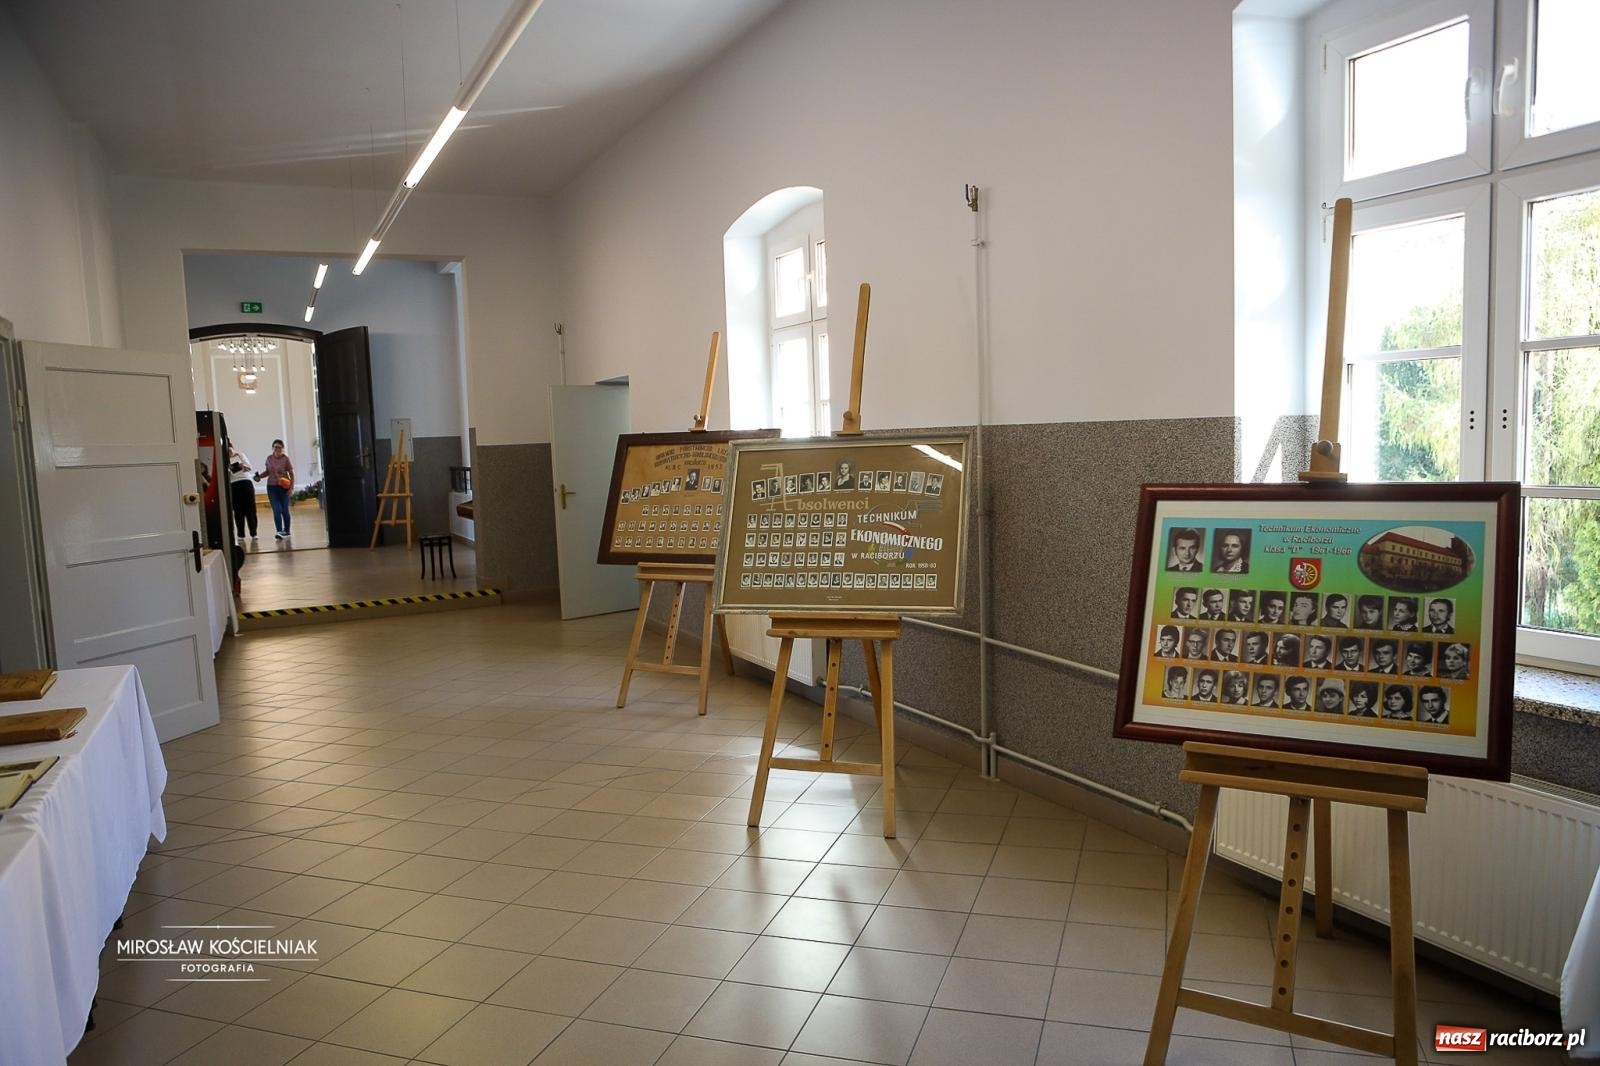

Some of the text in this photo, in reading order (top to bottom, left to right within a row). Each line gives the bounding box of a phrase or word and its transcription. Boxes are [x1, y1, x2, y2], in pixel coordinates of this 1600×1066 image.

[857, 510, 917, 524] TECHNIKUM
[1259, 524, 1361, 534] Technikum Ekonomiczne
[850, 528, 943, 551] EKONOMICZNEGO
[1291, 535, 1334, 544] Raciborzu
[860, 552, 905, 560] RACIBORZU
